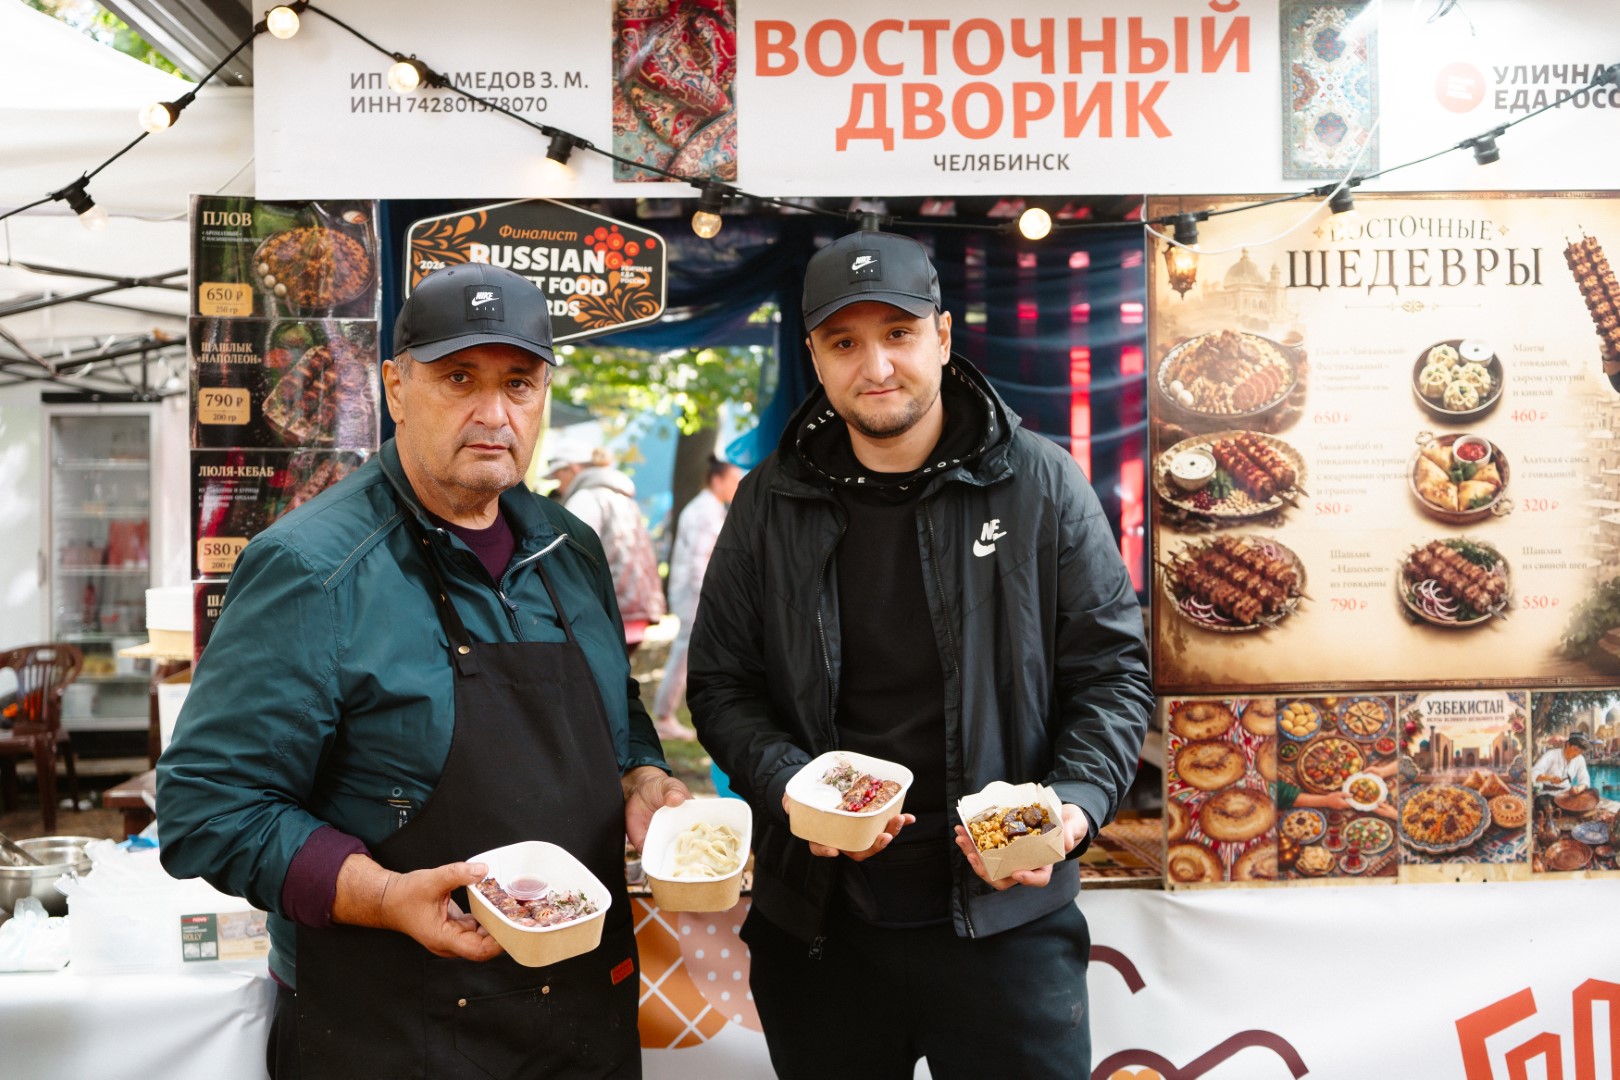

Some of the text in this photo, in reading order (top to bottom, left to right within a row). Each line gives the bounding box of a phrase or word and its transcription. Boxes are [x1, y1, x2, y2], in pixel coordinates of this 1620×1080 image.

[754, 0, 1251, 77] ВОСТОЧНЫЙ
[351, 73, 382, 89] ИП
[389, 72, 534, 91] АМЕДОВ
[564, 72, 589, 89] М.
[1493, 64, 1612, 85] УЛИЧНА
[351, 96, 401, 113] ИНН
[1494, 90, 1548, 113] ЕДА
[835, 80, 1173, 152] ДВОРИК
[933, 152, 1071, 173] ЧЕЛЯБИНСК
[202, 211, 252, 227] ПЛОВ
[499, 225, 579, 241] Финалист
[470, 244, 605, 274] RUSSIAN
[1285, 247, 1543, 296] ШЕДЕВРЫ
[207, 287, 232, 301] 650
[548, 276, 608, 297] FOOD
[201, 342, 253, 353] ШАШЛЫК
[197, 353, 262, 364] «НАПОЛЕОН»
[205, 394, 233, 407] 790
[1313, 410, 1341, 424] 650
[1510, 408, 1537, 423] 460
[197, 465, 275, 477] ЛЮЛЯ-КЕБАБ
[1314, 502, 1341, 516] 580
[1522, 498, 1549, 512] 320
[204, 543, 231, 556] 580
[1330, 598, 1357, 611] 790
[1522, 595, 1549, 610] 550
[1426, 699, 1504, 715] УЗБЕКИСТАН
